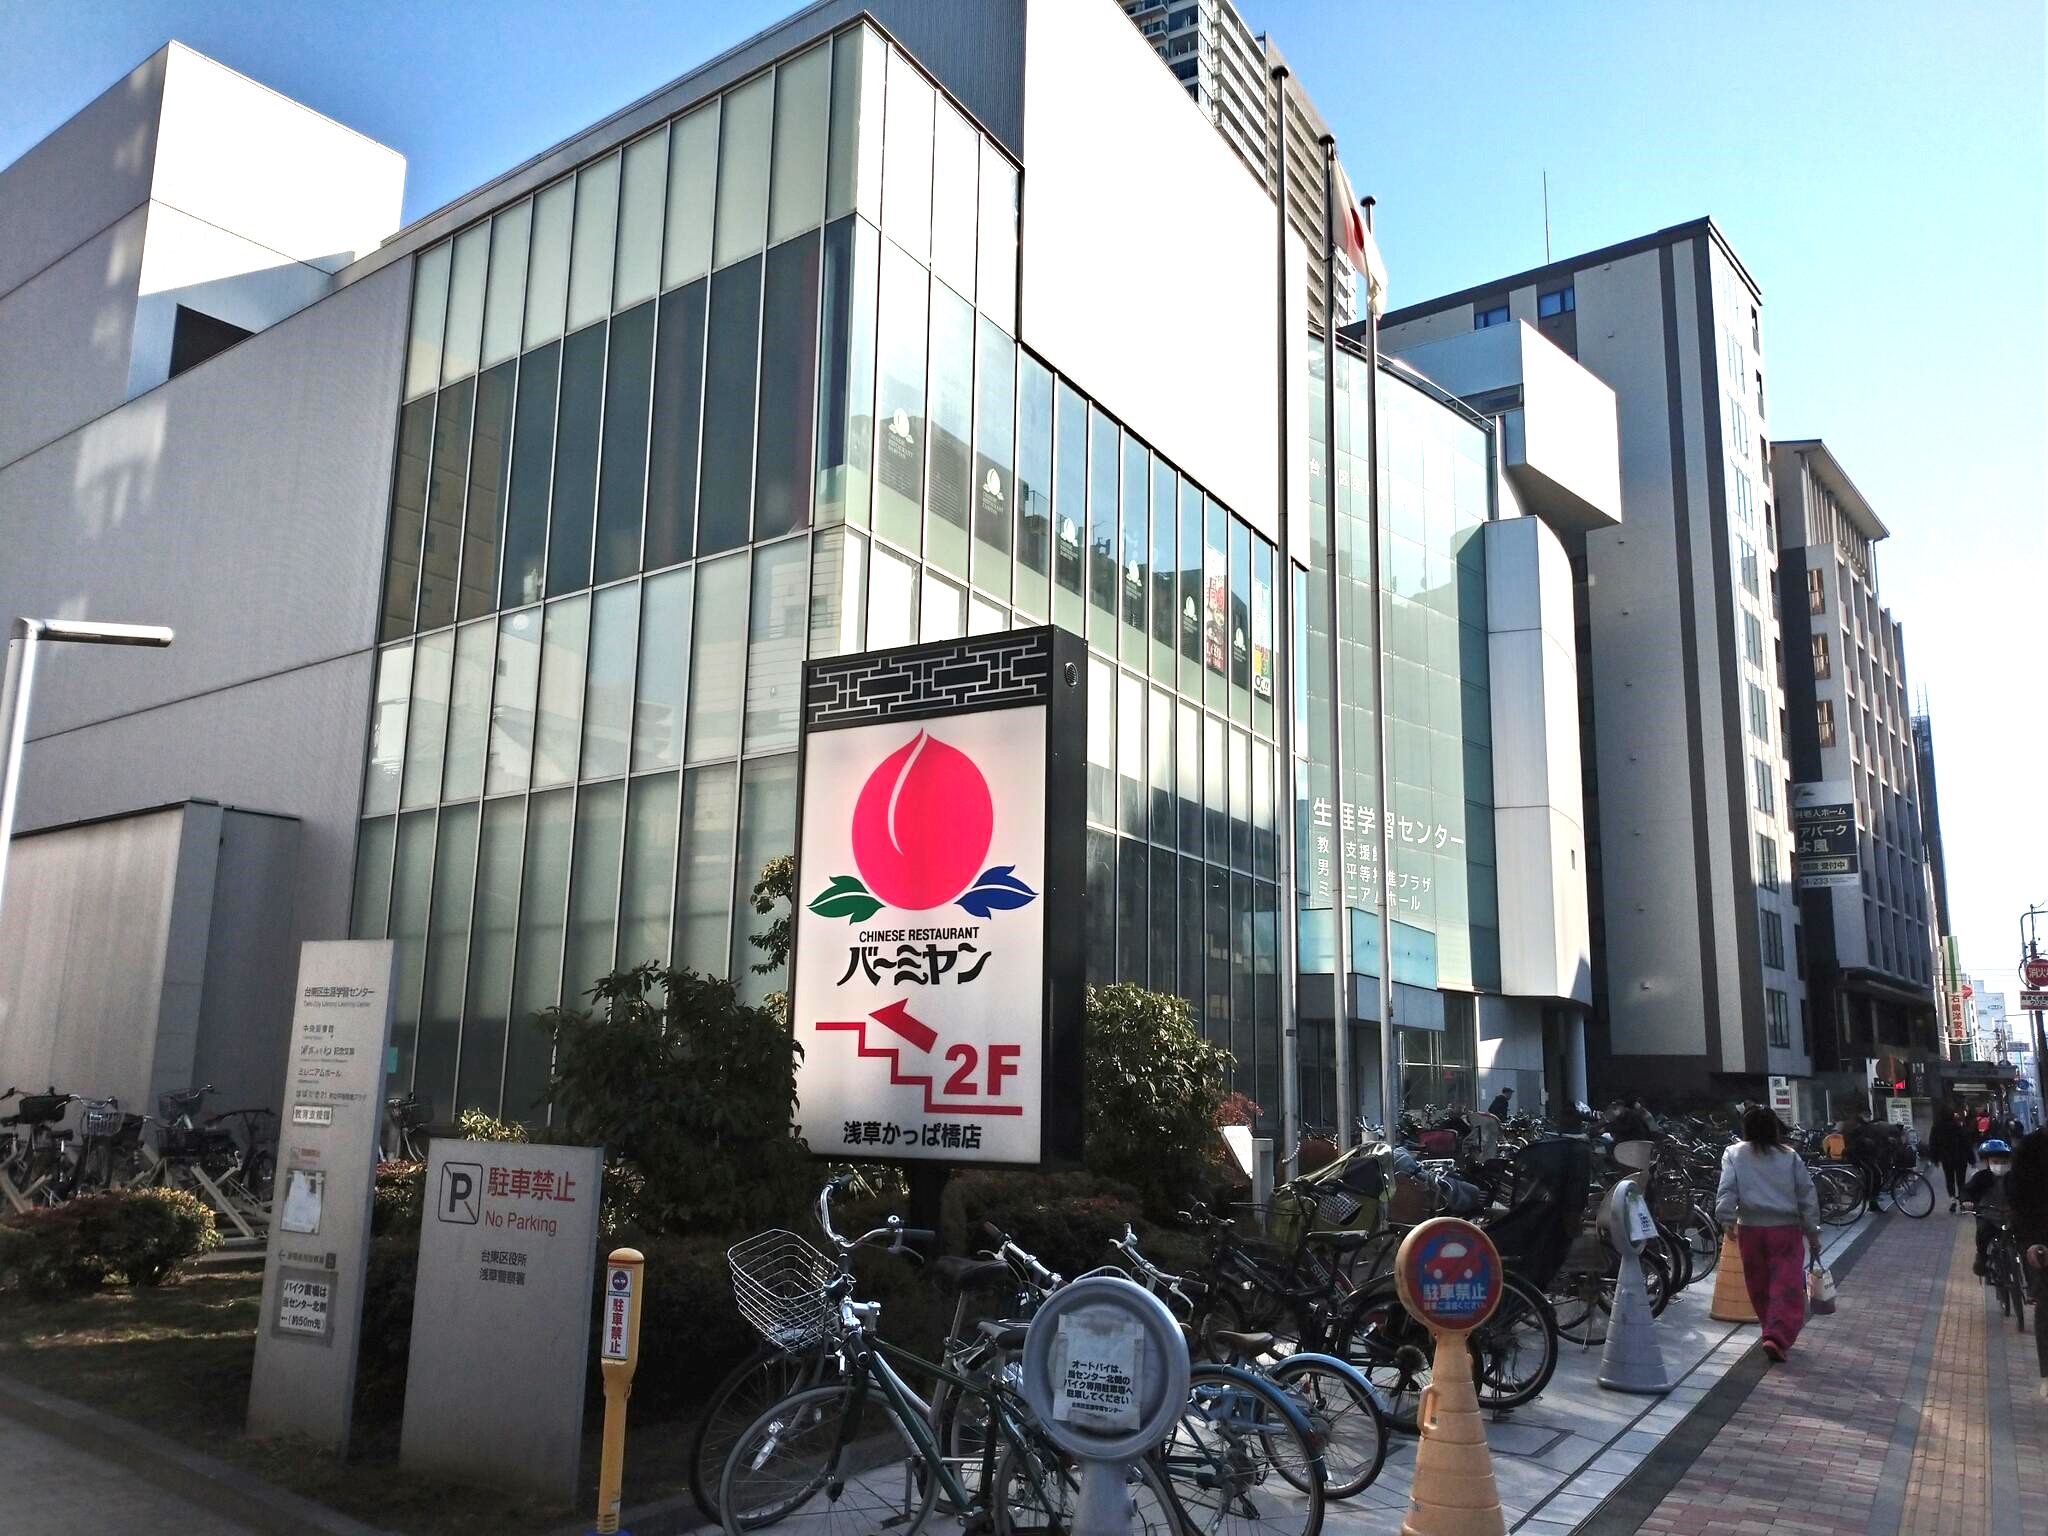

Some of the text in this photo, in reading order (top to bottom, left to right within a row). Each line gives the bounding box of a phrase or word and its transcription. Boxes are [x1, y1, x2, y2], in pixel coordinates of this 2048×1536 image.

[1317, 858, 1432, 893] 男平等進プラザ
[1318, 880, 1421, 911] ミニアホール
[859, 926, 979, 943] CHINESE RESTAURANT
[836, 942, 992, 986] バーミヤン
[943, 1043, 1020, 1096] 2F
[843, 1120, 981, 1149] 浅草かっぱ橋店
[487, 1167, 576, 1202] 駐車禁止
[485, 1210, 558, 1237] No Parking
[1423, 1283, 1487, 1302] 駐車禁止
[609, 1298, 624, 1354] 駐車禁止
